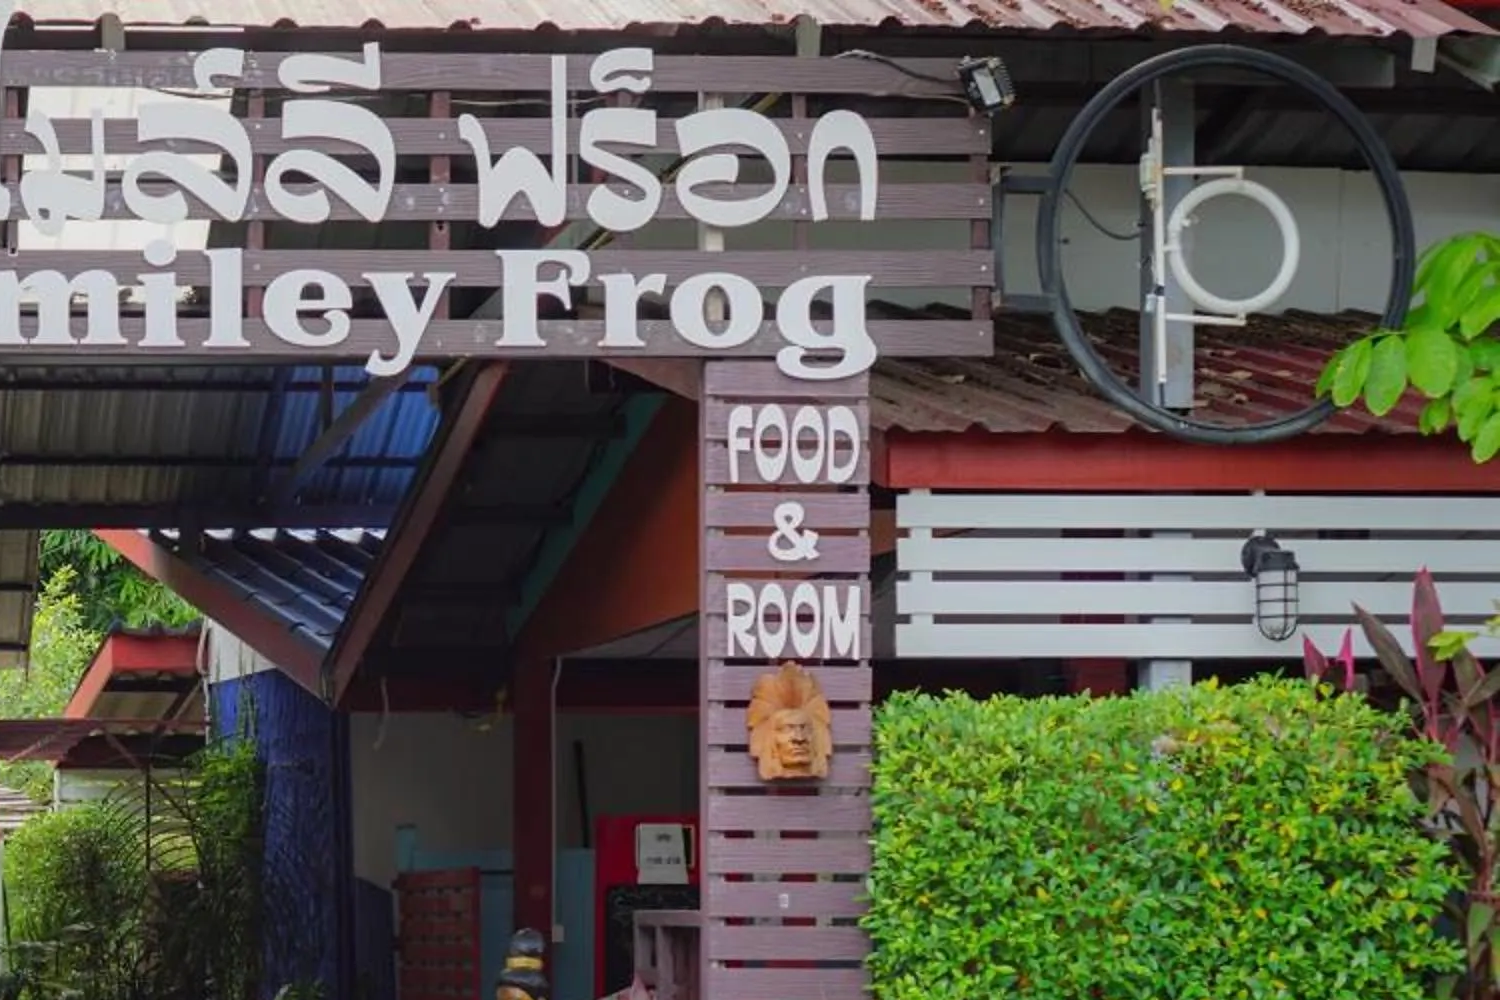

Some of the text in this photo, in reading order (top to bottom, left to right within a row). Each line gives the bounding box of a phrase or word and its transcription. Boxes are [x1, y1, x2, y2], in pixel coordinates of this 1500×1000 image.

[458, 47, 878, 231] ฟร็อก
[496, 250, 878, 380] Frog
[728, 403, 861, 484] FOOD
[767, 501, 819, 562] &
[726, 582, 861, 661] ROOM
